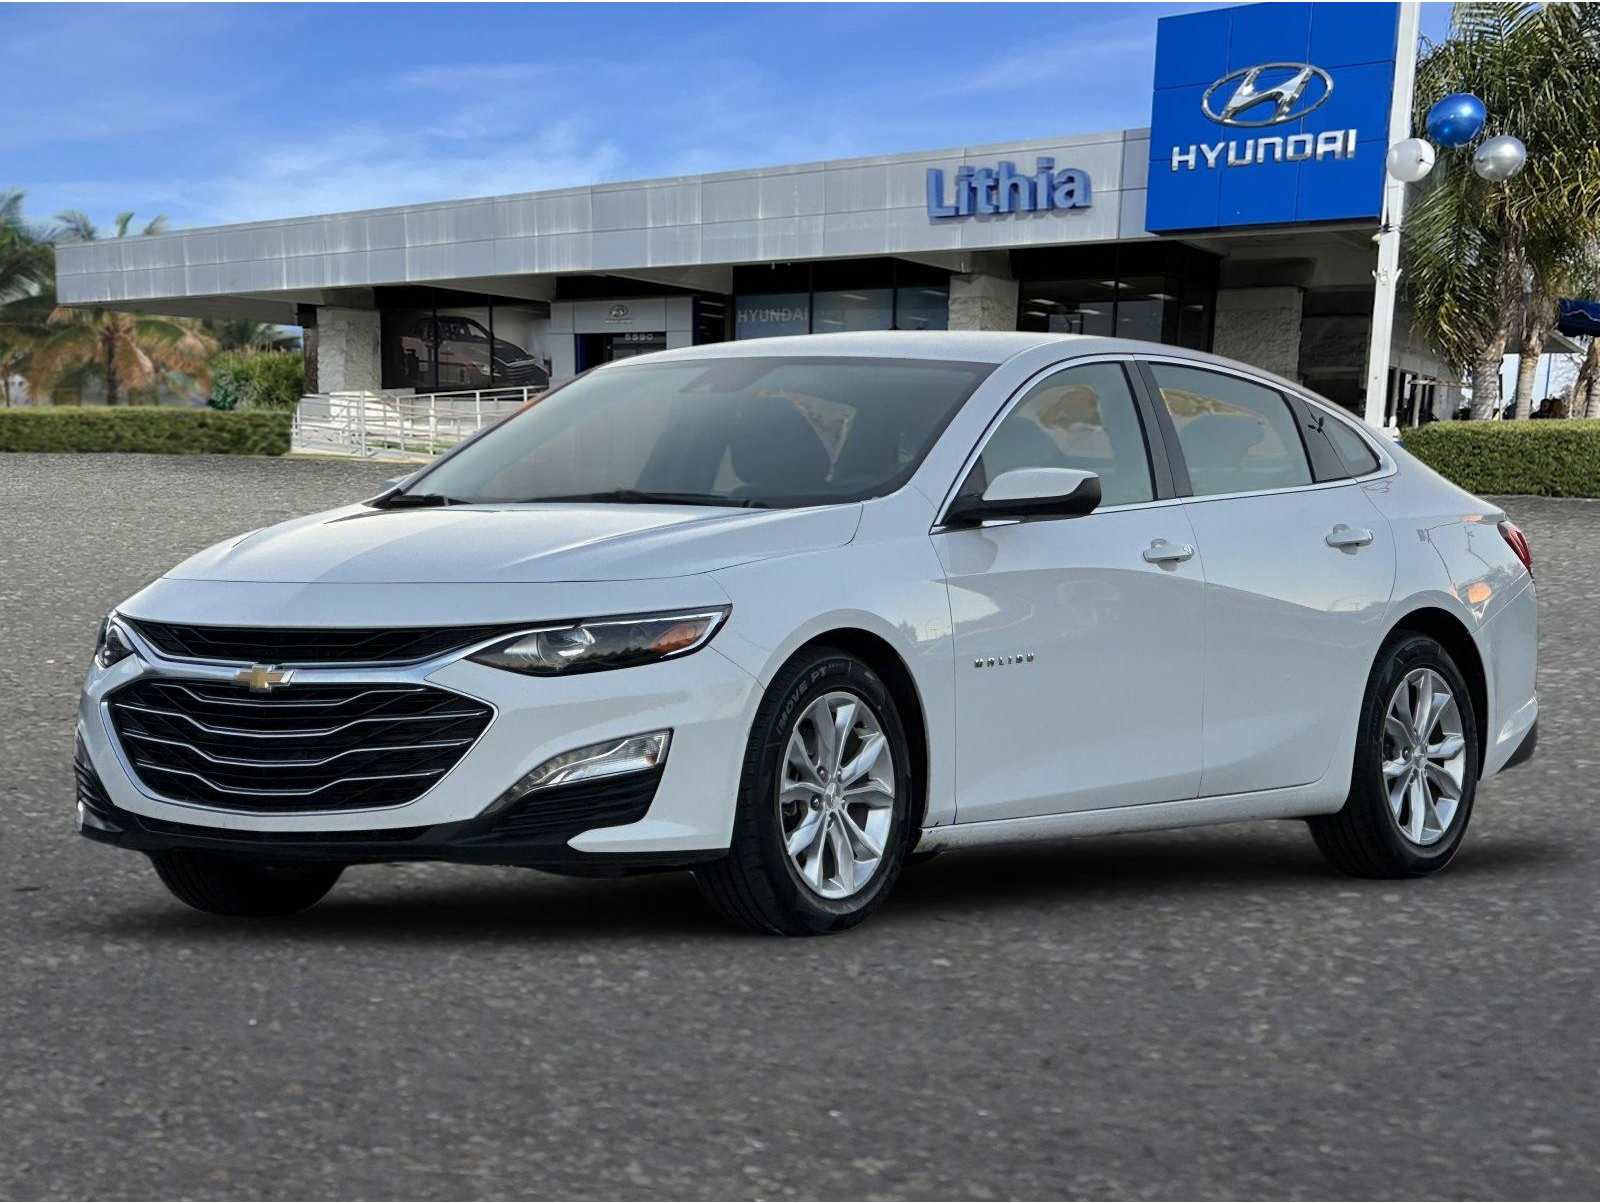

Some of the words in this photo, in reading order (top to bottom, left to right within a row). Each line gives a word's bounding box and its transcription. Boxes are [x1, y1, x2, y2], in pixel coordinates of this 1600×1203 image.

[1171, 128, 1357, 171] HYUNDAI
[926, 156, 1092, 218] Lithia
[737, 307, 809, 322] HYUNDAI
[974, 653, 1034, 668] MALIBU
